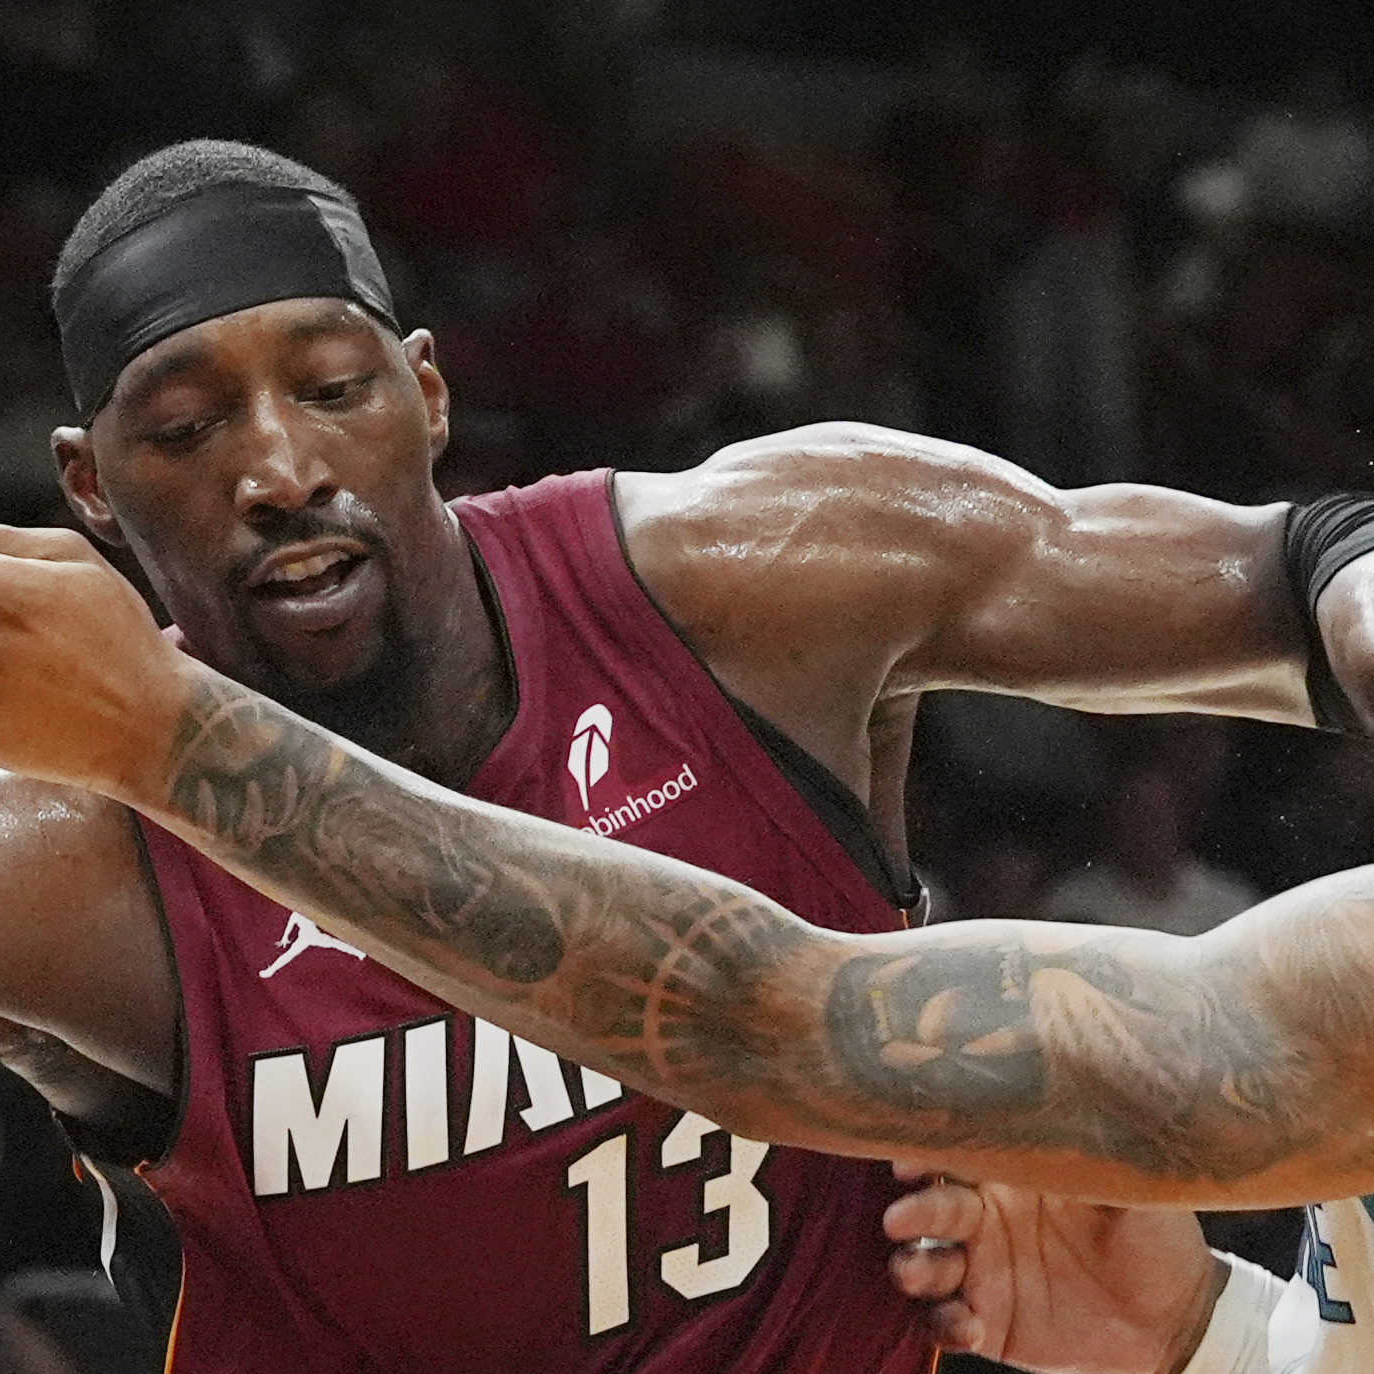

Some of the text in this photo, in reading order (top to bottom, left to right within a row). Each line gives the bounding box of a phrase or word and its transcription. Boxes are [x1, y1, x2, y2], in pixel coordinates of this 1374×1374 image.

[580, 763, 698, 836] binhood
[250, 1014, 624, 1198] MIA
[565, 1109, 771, 1338] 13
